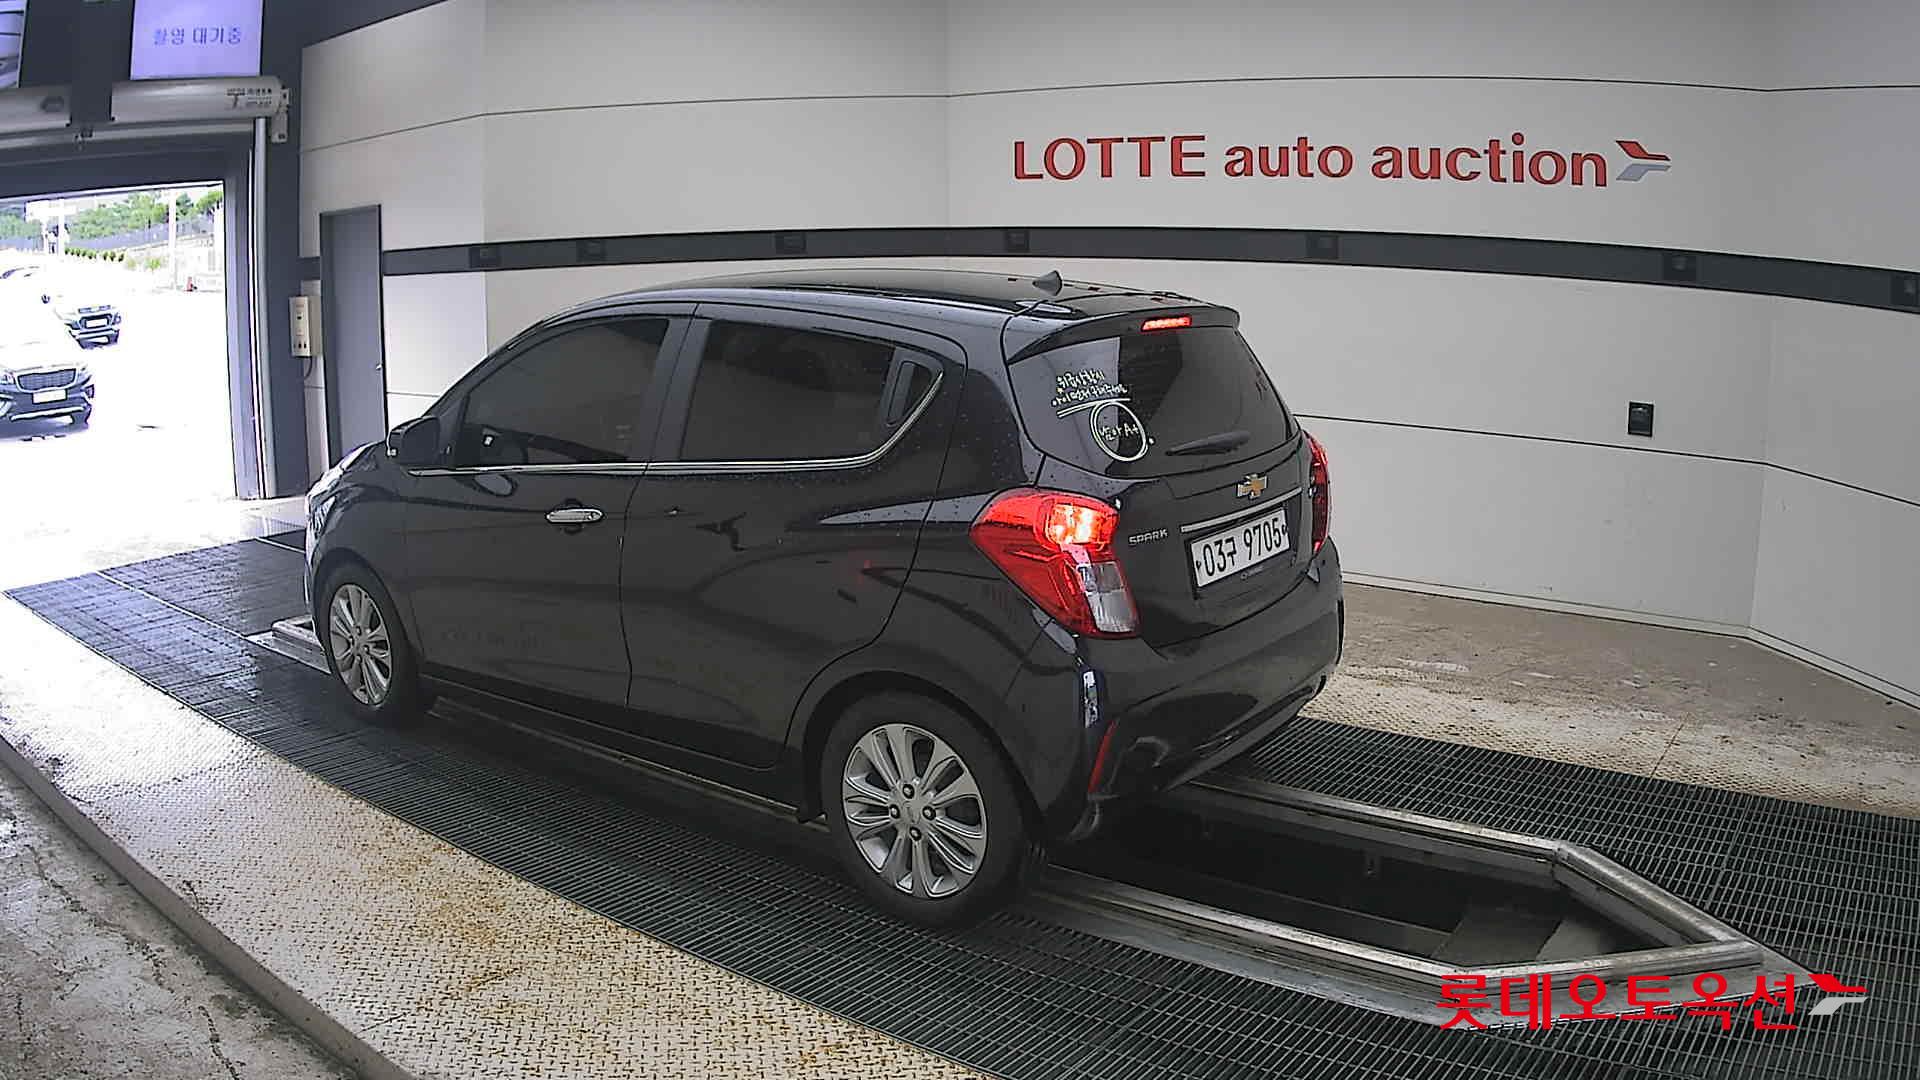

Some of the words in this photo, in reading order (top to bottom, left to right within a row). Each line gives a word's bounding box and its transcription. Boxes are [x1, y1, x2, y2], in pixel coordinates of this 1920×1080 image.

[192, 27, 241, 46] 대기중
[1013, 135, 1206, 180] LOTTE
[1223, 136, 1353, 179] auto
[1370, 132, 1608, 187] auction
[1128, 529, 1168, 543] SPARK
[1202, 536, 1237, 577] 03구
[1243, 517, 1282, 561] 9705
